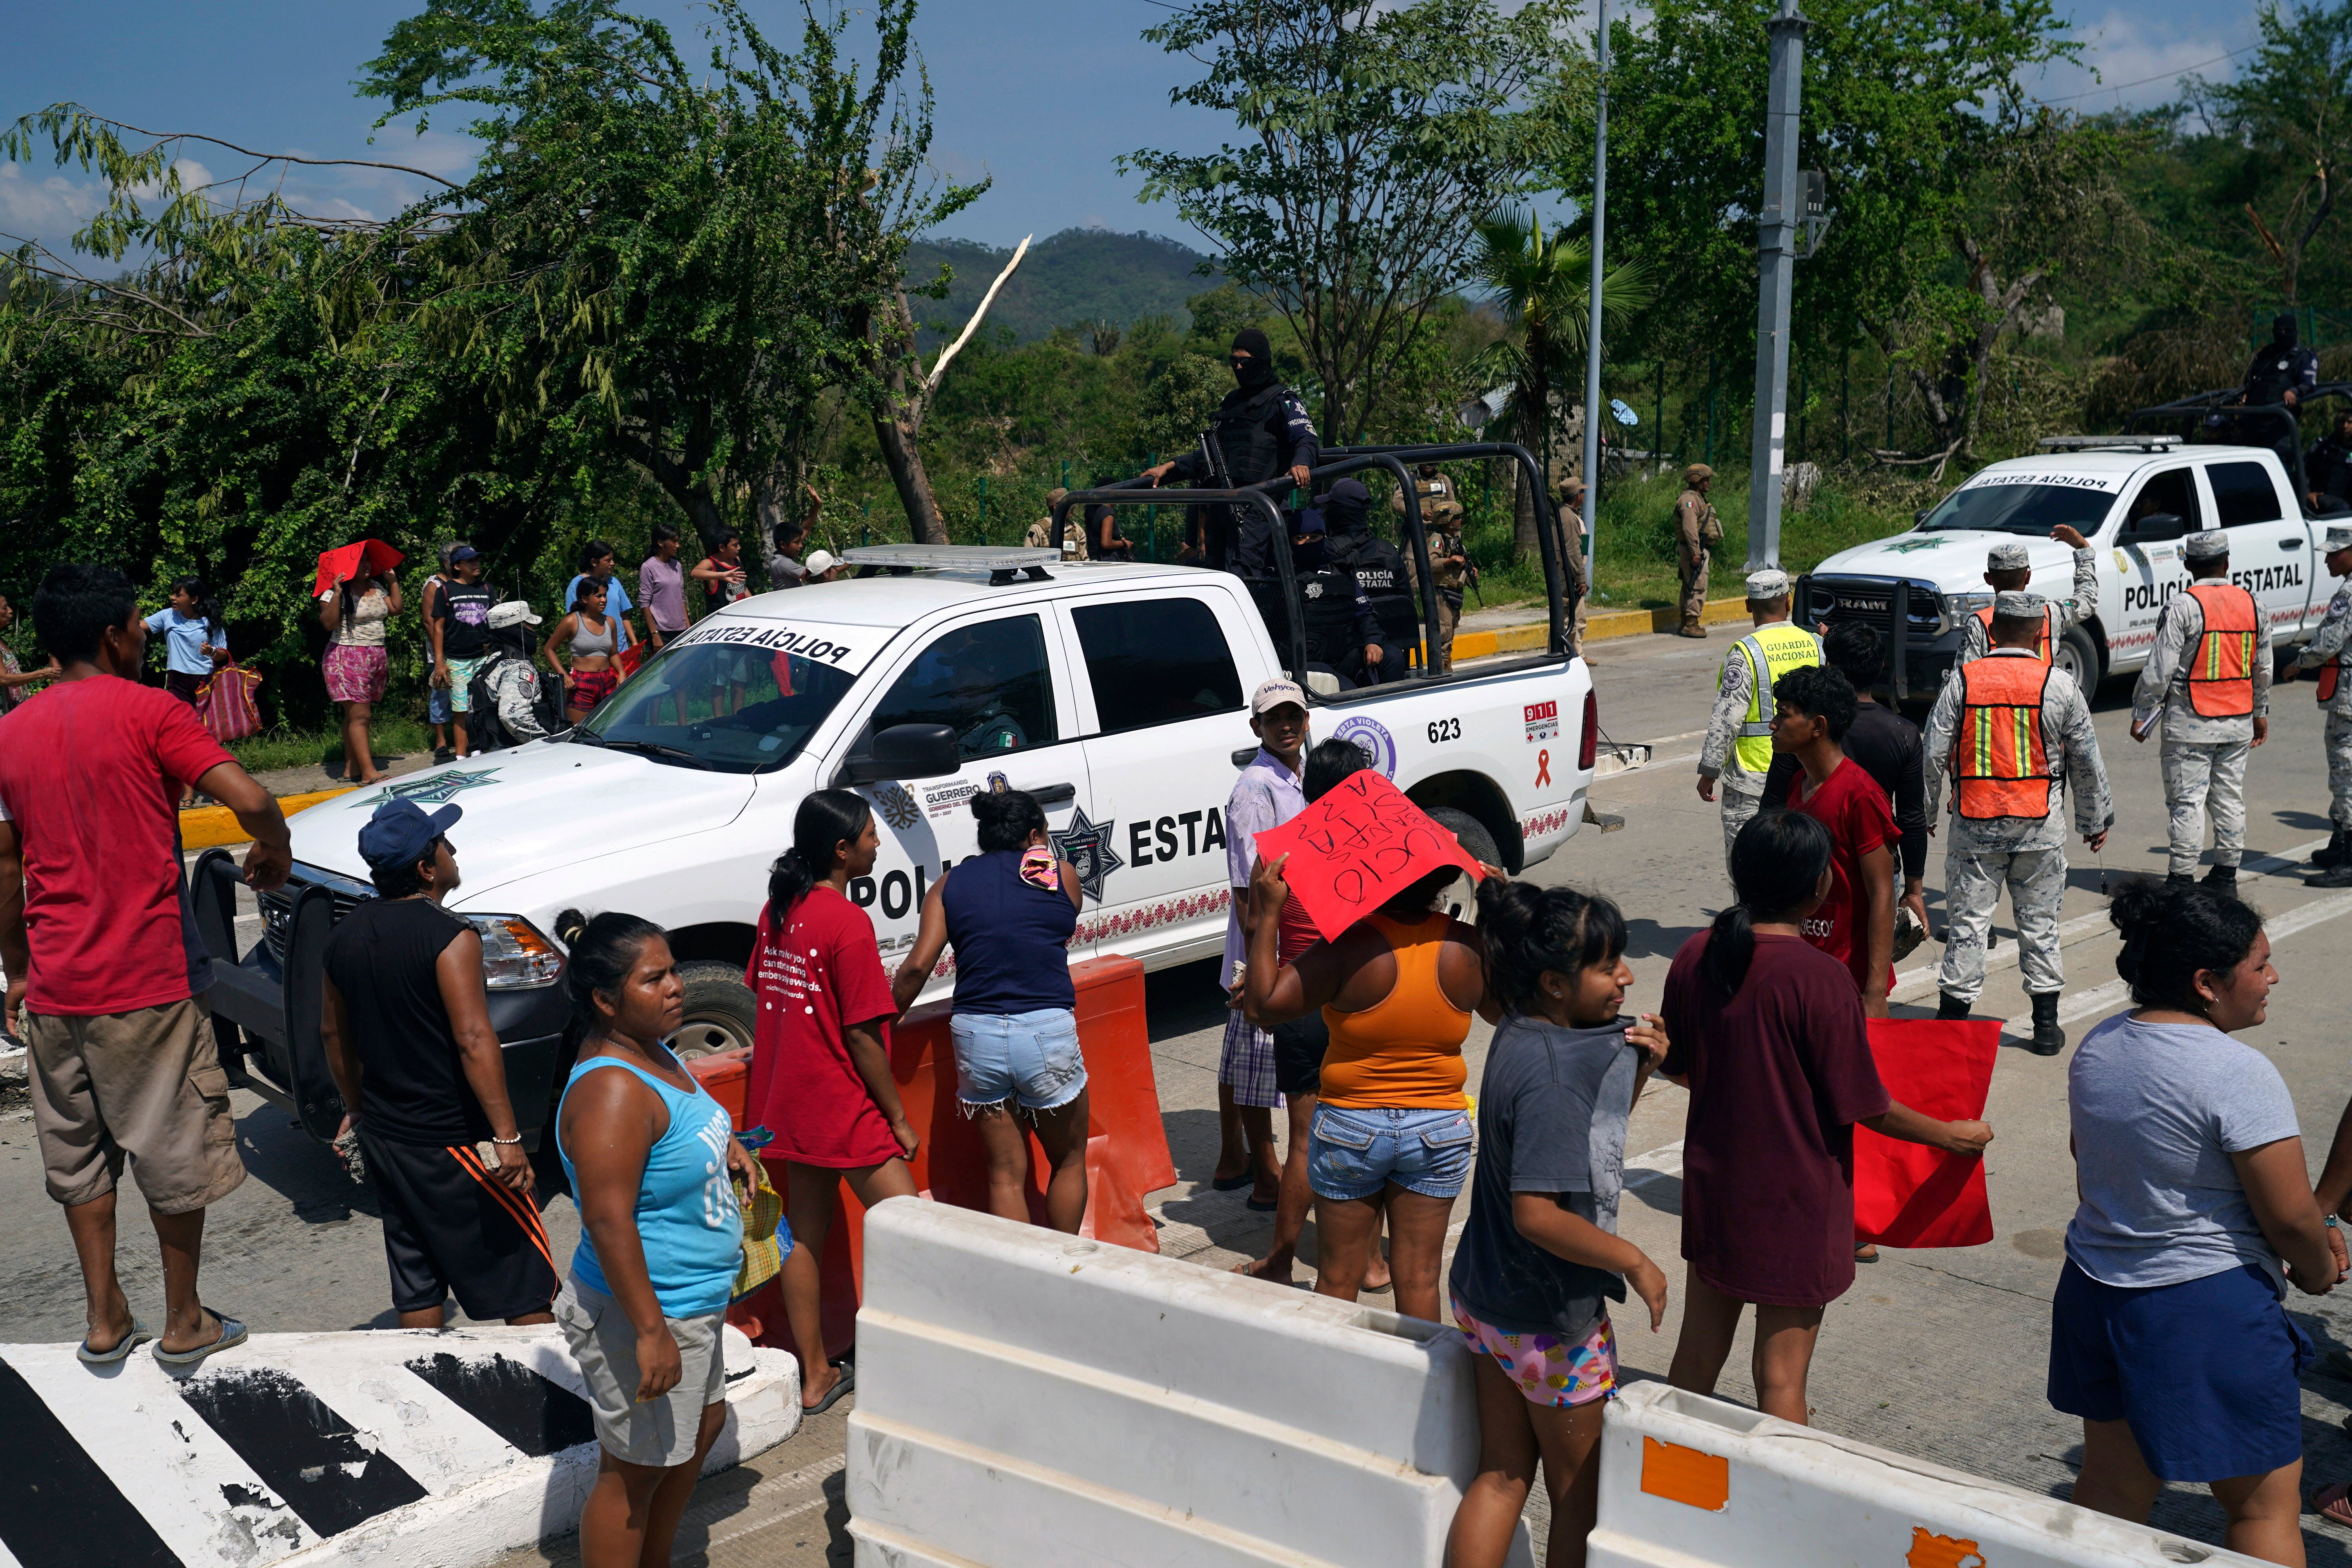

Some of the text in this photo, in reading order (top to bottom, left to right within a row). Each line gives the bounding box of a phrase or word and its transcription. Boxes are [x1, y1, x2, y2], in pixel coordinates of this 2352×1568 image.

[1356, 569, 1394, 579] OLICÍA
[2232, 563, 2303, 592] ESTATAL
[1837, 598, 1887, 610] RAM
[1766, 639, 1813, 651] GUARDIA
[1767, 650, 1818, 662] NACIONAL
[1264, 683, 1295, 693] Vehyco
[1526, 703, 1554, 719] 911
[1357, 718, 1389, 741] VIOLETA
[1428, 718, 1461, 744] 623
[1526, 721, 1558, 732] EMERGENCIAS
[922, 779, 968, 793] TRANSFORMANDO
[926, 784, 981, 803] GUERRERO
[928, 803, 952, 813] GOBIERNO
[1129, 805, 1228, 868] ESTA
[764, 945, 777, 956] Ask
[793, 954, 806, 965] you
[763, 959, 776, 967] can
